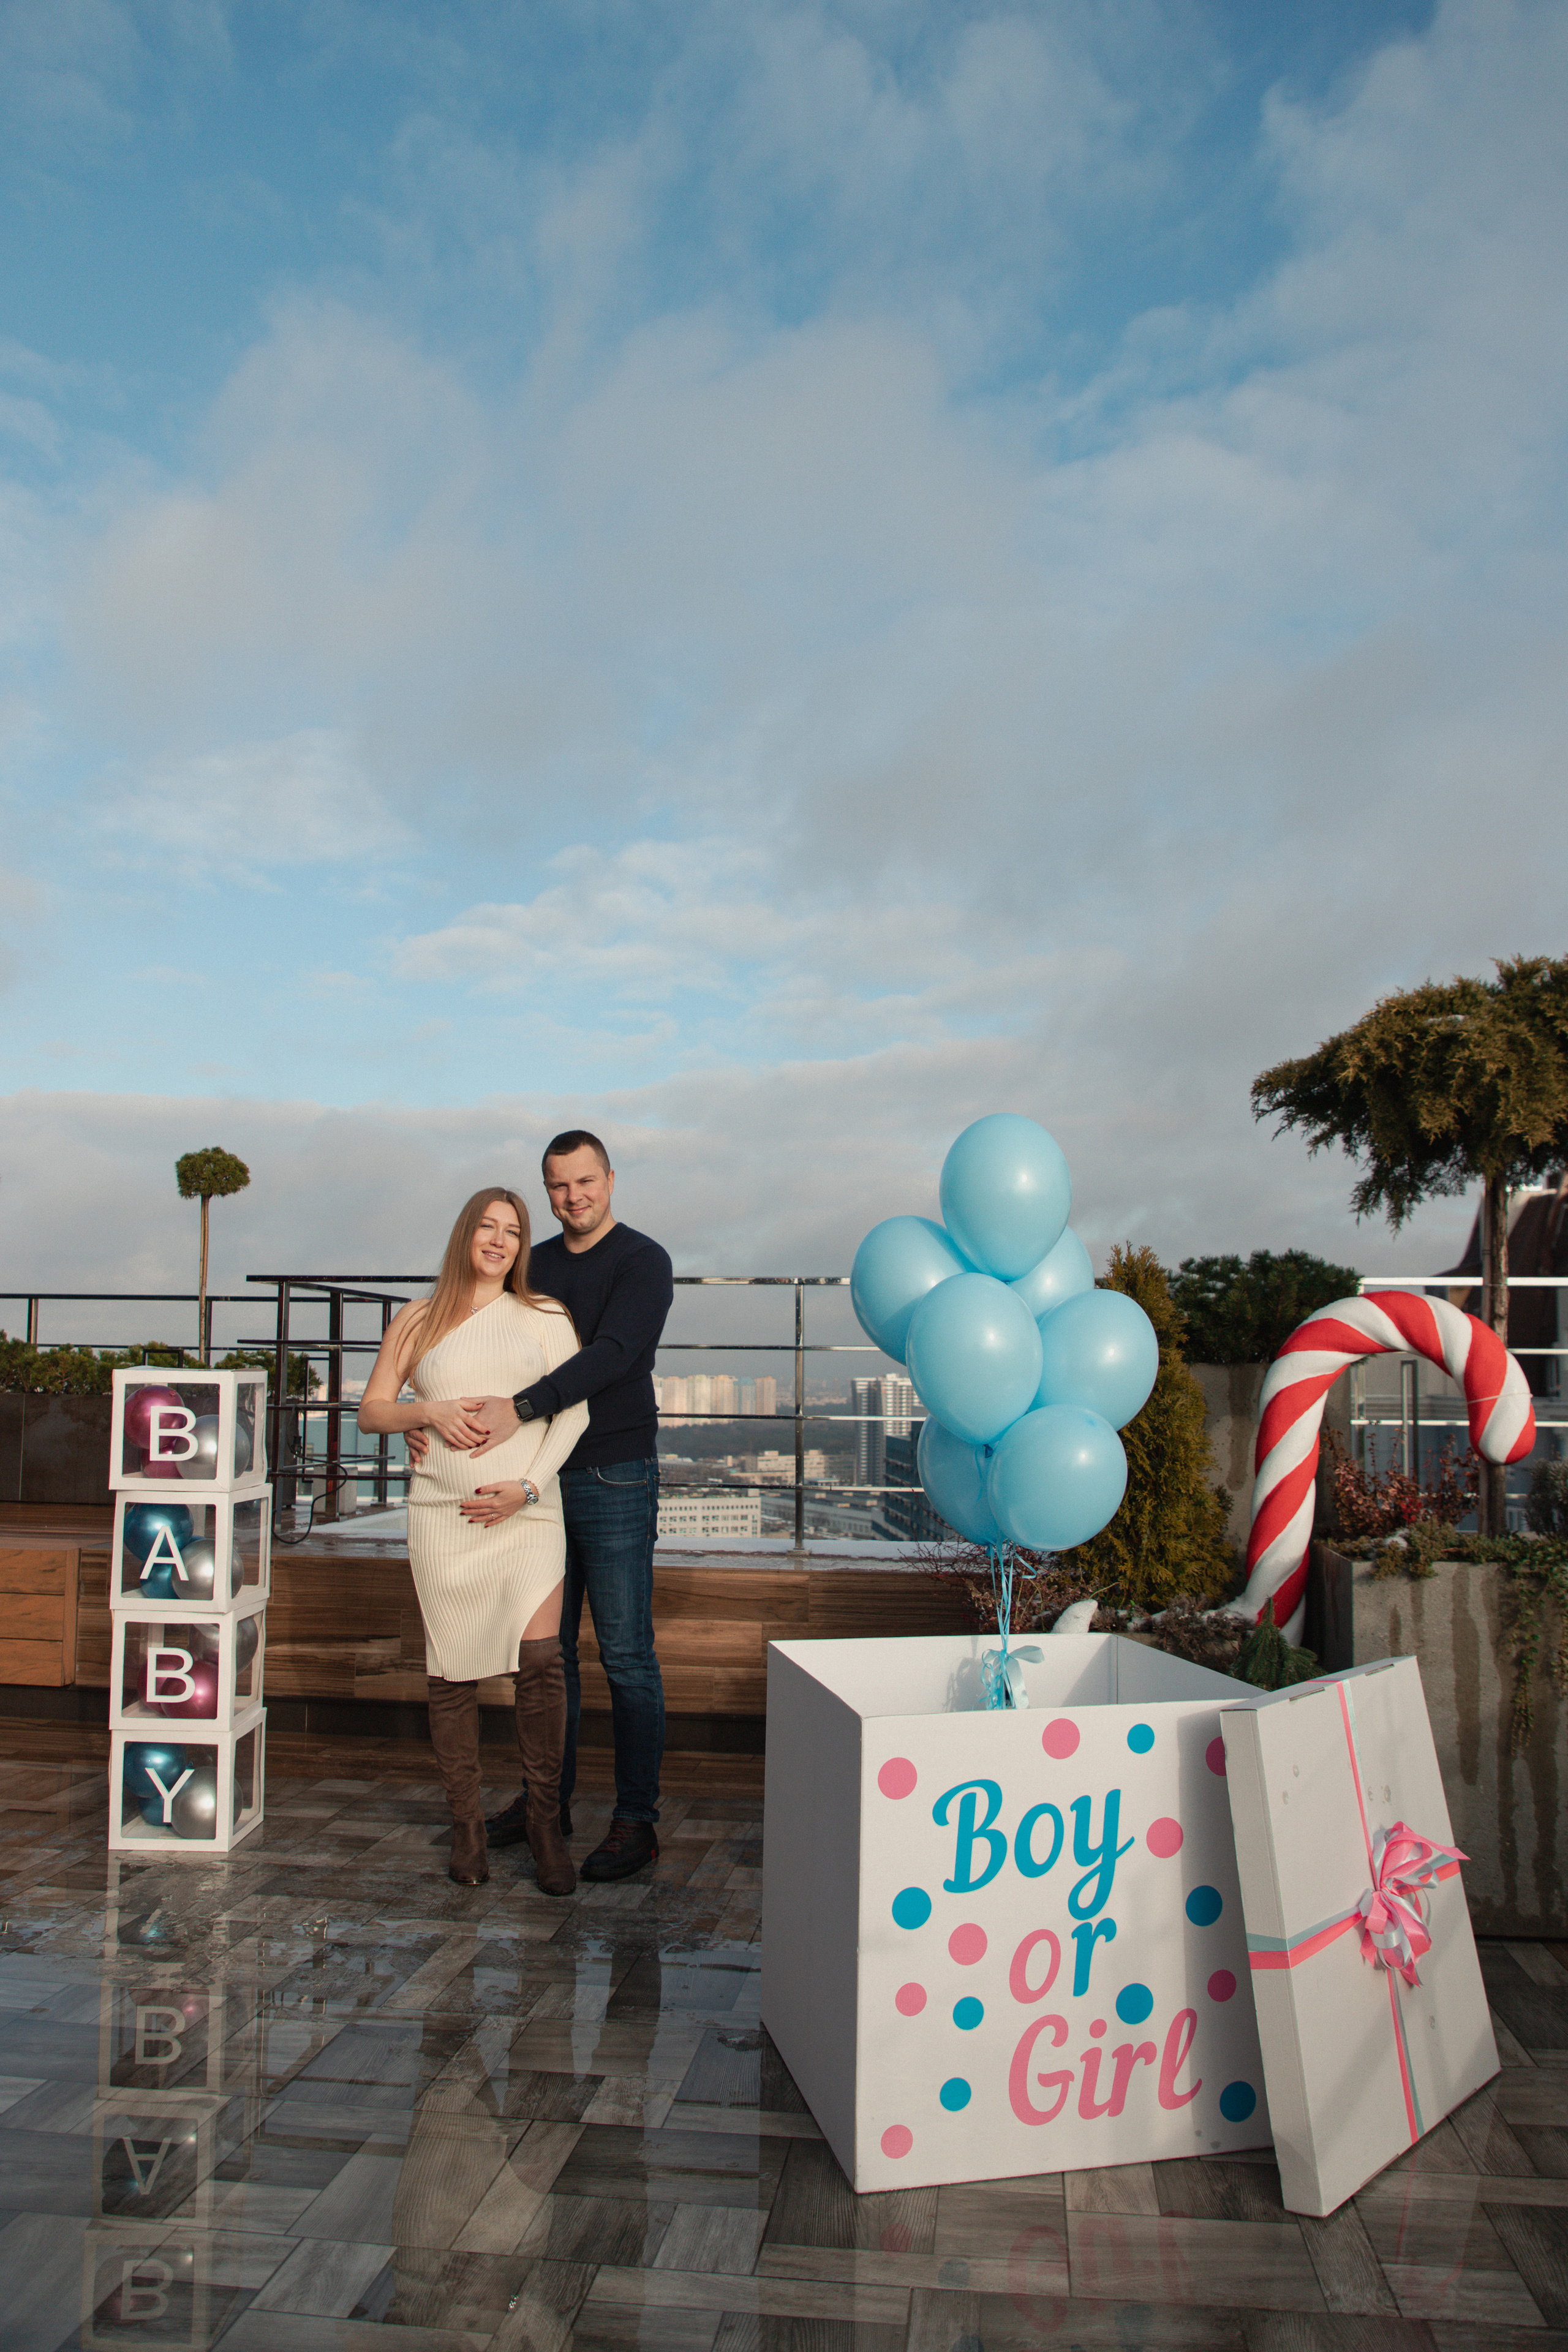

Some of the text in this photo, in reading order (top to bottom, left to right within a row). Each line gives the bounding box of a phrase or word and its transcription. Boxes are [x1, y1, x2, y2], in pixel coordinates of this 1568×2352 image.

[932, 1779, 1136, 1921] Boy
[1008, 1917, 1118, 2005] or
[1008, 2007, 1203, 2127] Girl
